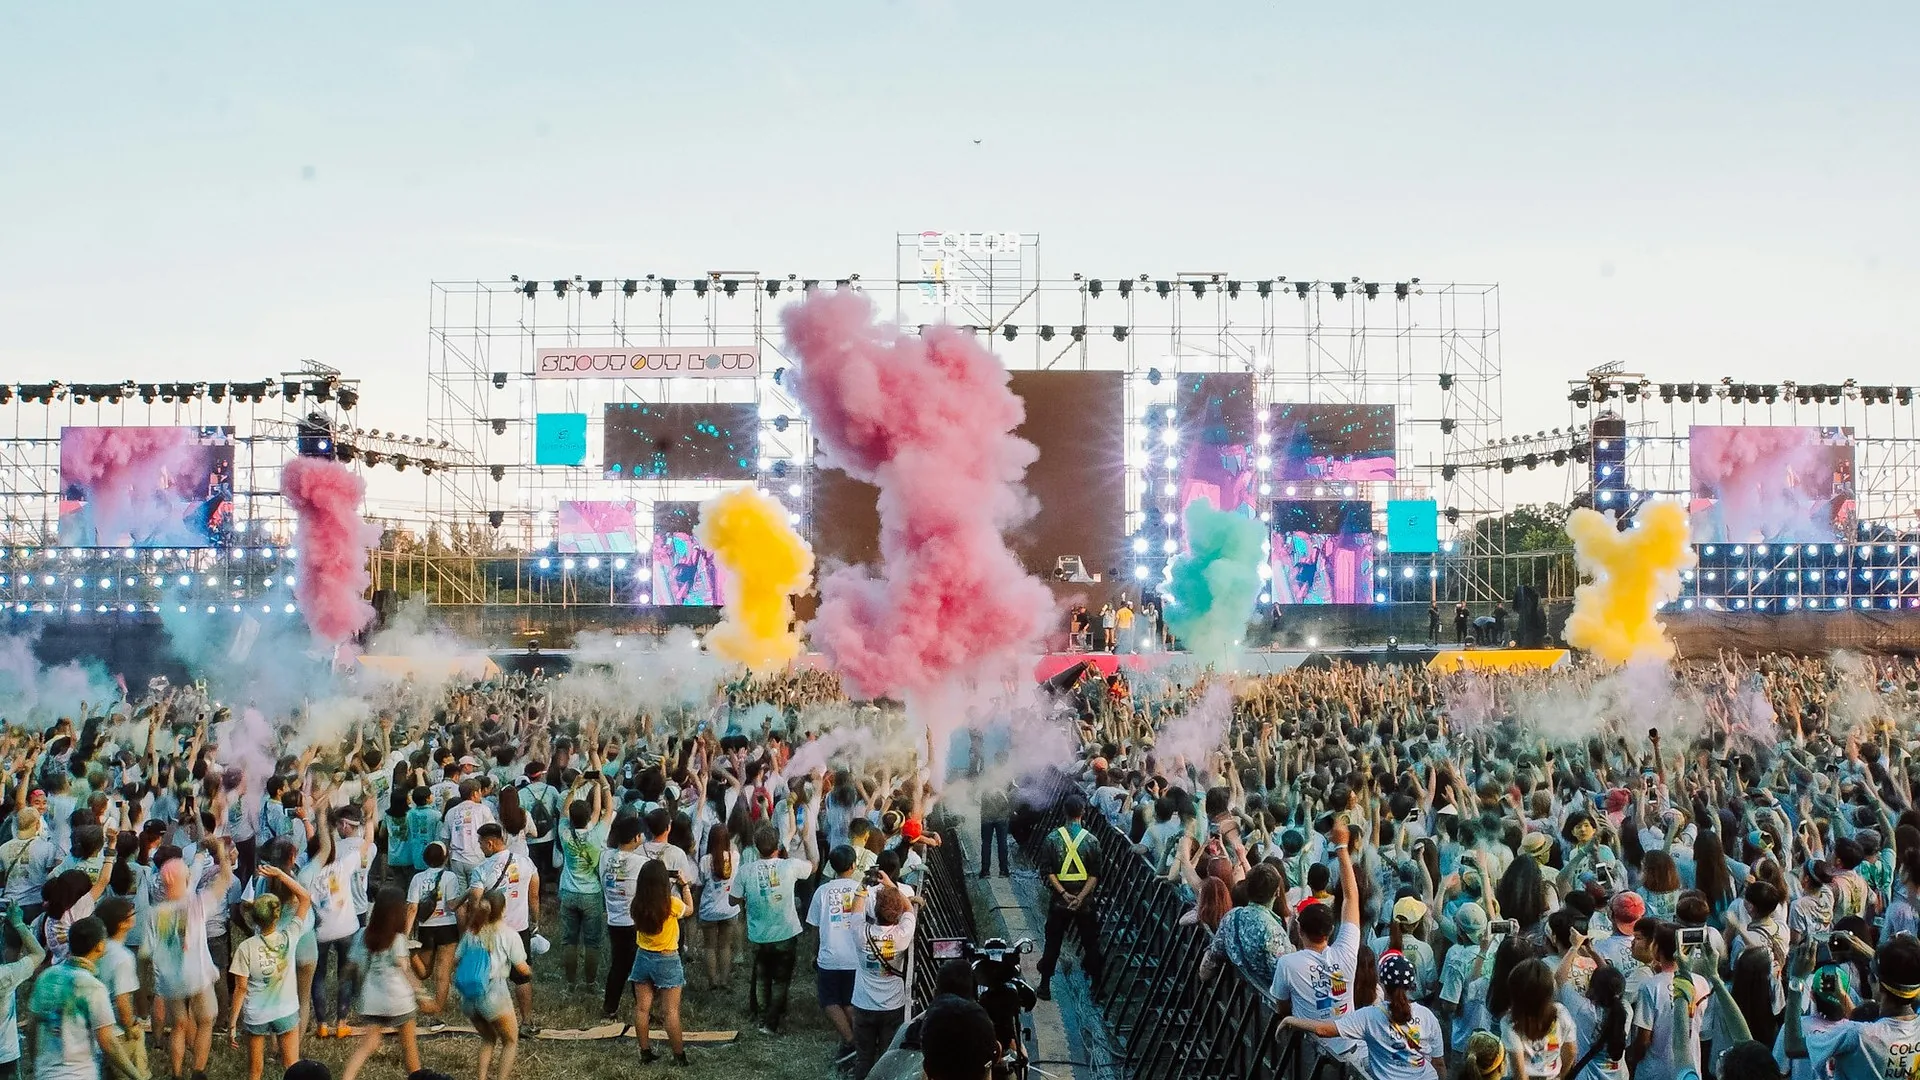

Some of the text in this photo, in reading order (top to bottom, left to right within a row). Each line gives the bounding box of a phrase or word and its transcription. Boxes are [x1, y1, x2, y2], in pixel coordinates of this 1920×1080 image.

[919, 230, 1021, 253] COLOR
[541, 352, 755, 372] SHOUT OUT LOUD
[1885, 1066, 1912, 1079] RUN
